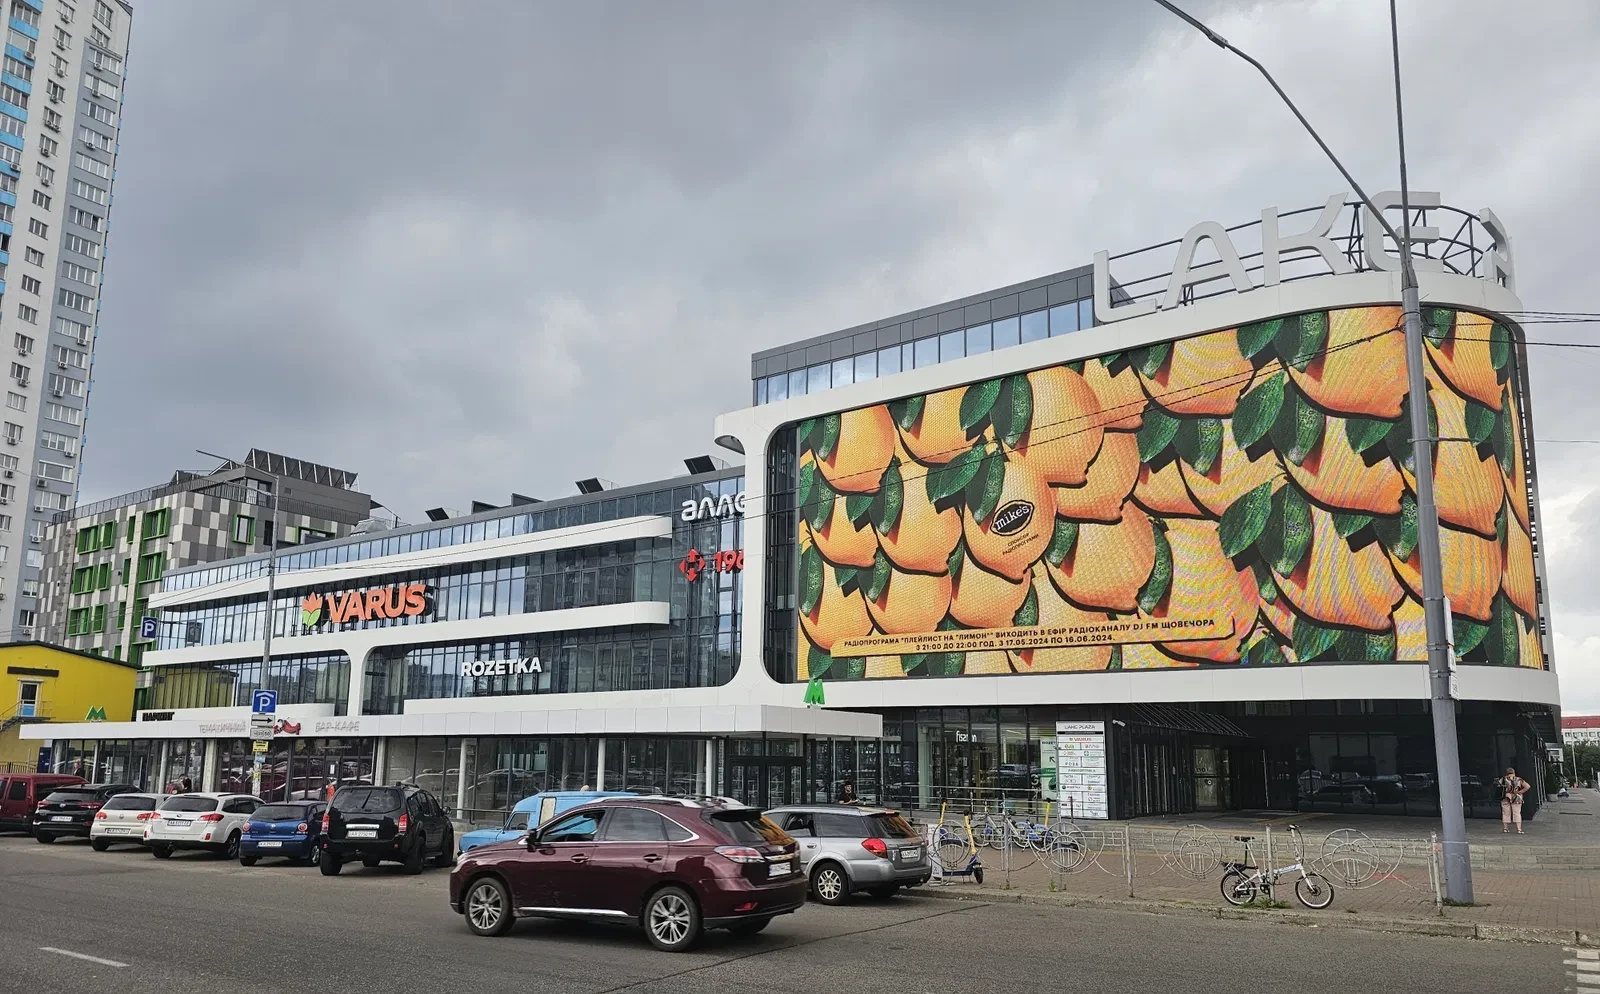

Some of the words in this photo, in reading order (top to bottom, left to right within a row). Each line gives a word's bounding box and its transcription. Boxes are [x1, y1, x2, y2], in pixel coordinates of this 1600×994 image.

[1093, 190, 1445, 324] LAKE
[995, 506, 1029, 530] mike's
[327, 583, 427, 624] VARUS
[844, 638, 899, 647] РАДІОПРОГРАМА
[995, 631, 1038, 639] ВИХОДИТЬ
[1048, 628, 1067, 636] ЕФІР
[1069, 624, 1130, 634] РАДІОКАНАЛУ
[1133, 623, 1143, 631] DJ
[1146, 622, 1159, 630] FM
[1161, 619, 1215, 629] ЩОВЕЧОРА
[956, 641, 977, 649] 22:00
[979, 640, 997, 649] ГОД.
[1006, 637, 1049, 646] 17.05.2024
[1051, 636, 1063, 644] ПО
[1065, 634, 1115, 643] 16.06.2024.
[461, 656, 543, 678] ROZETKA
[315, 720, 360, 733] БАР-КАФЕ
